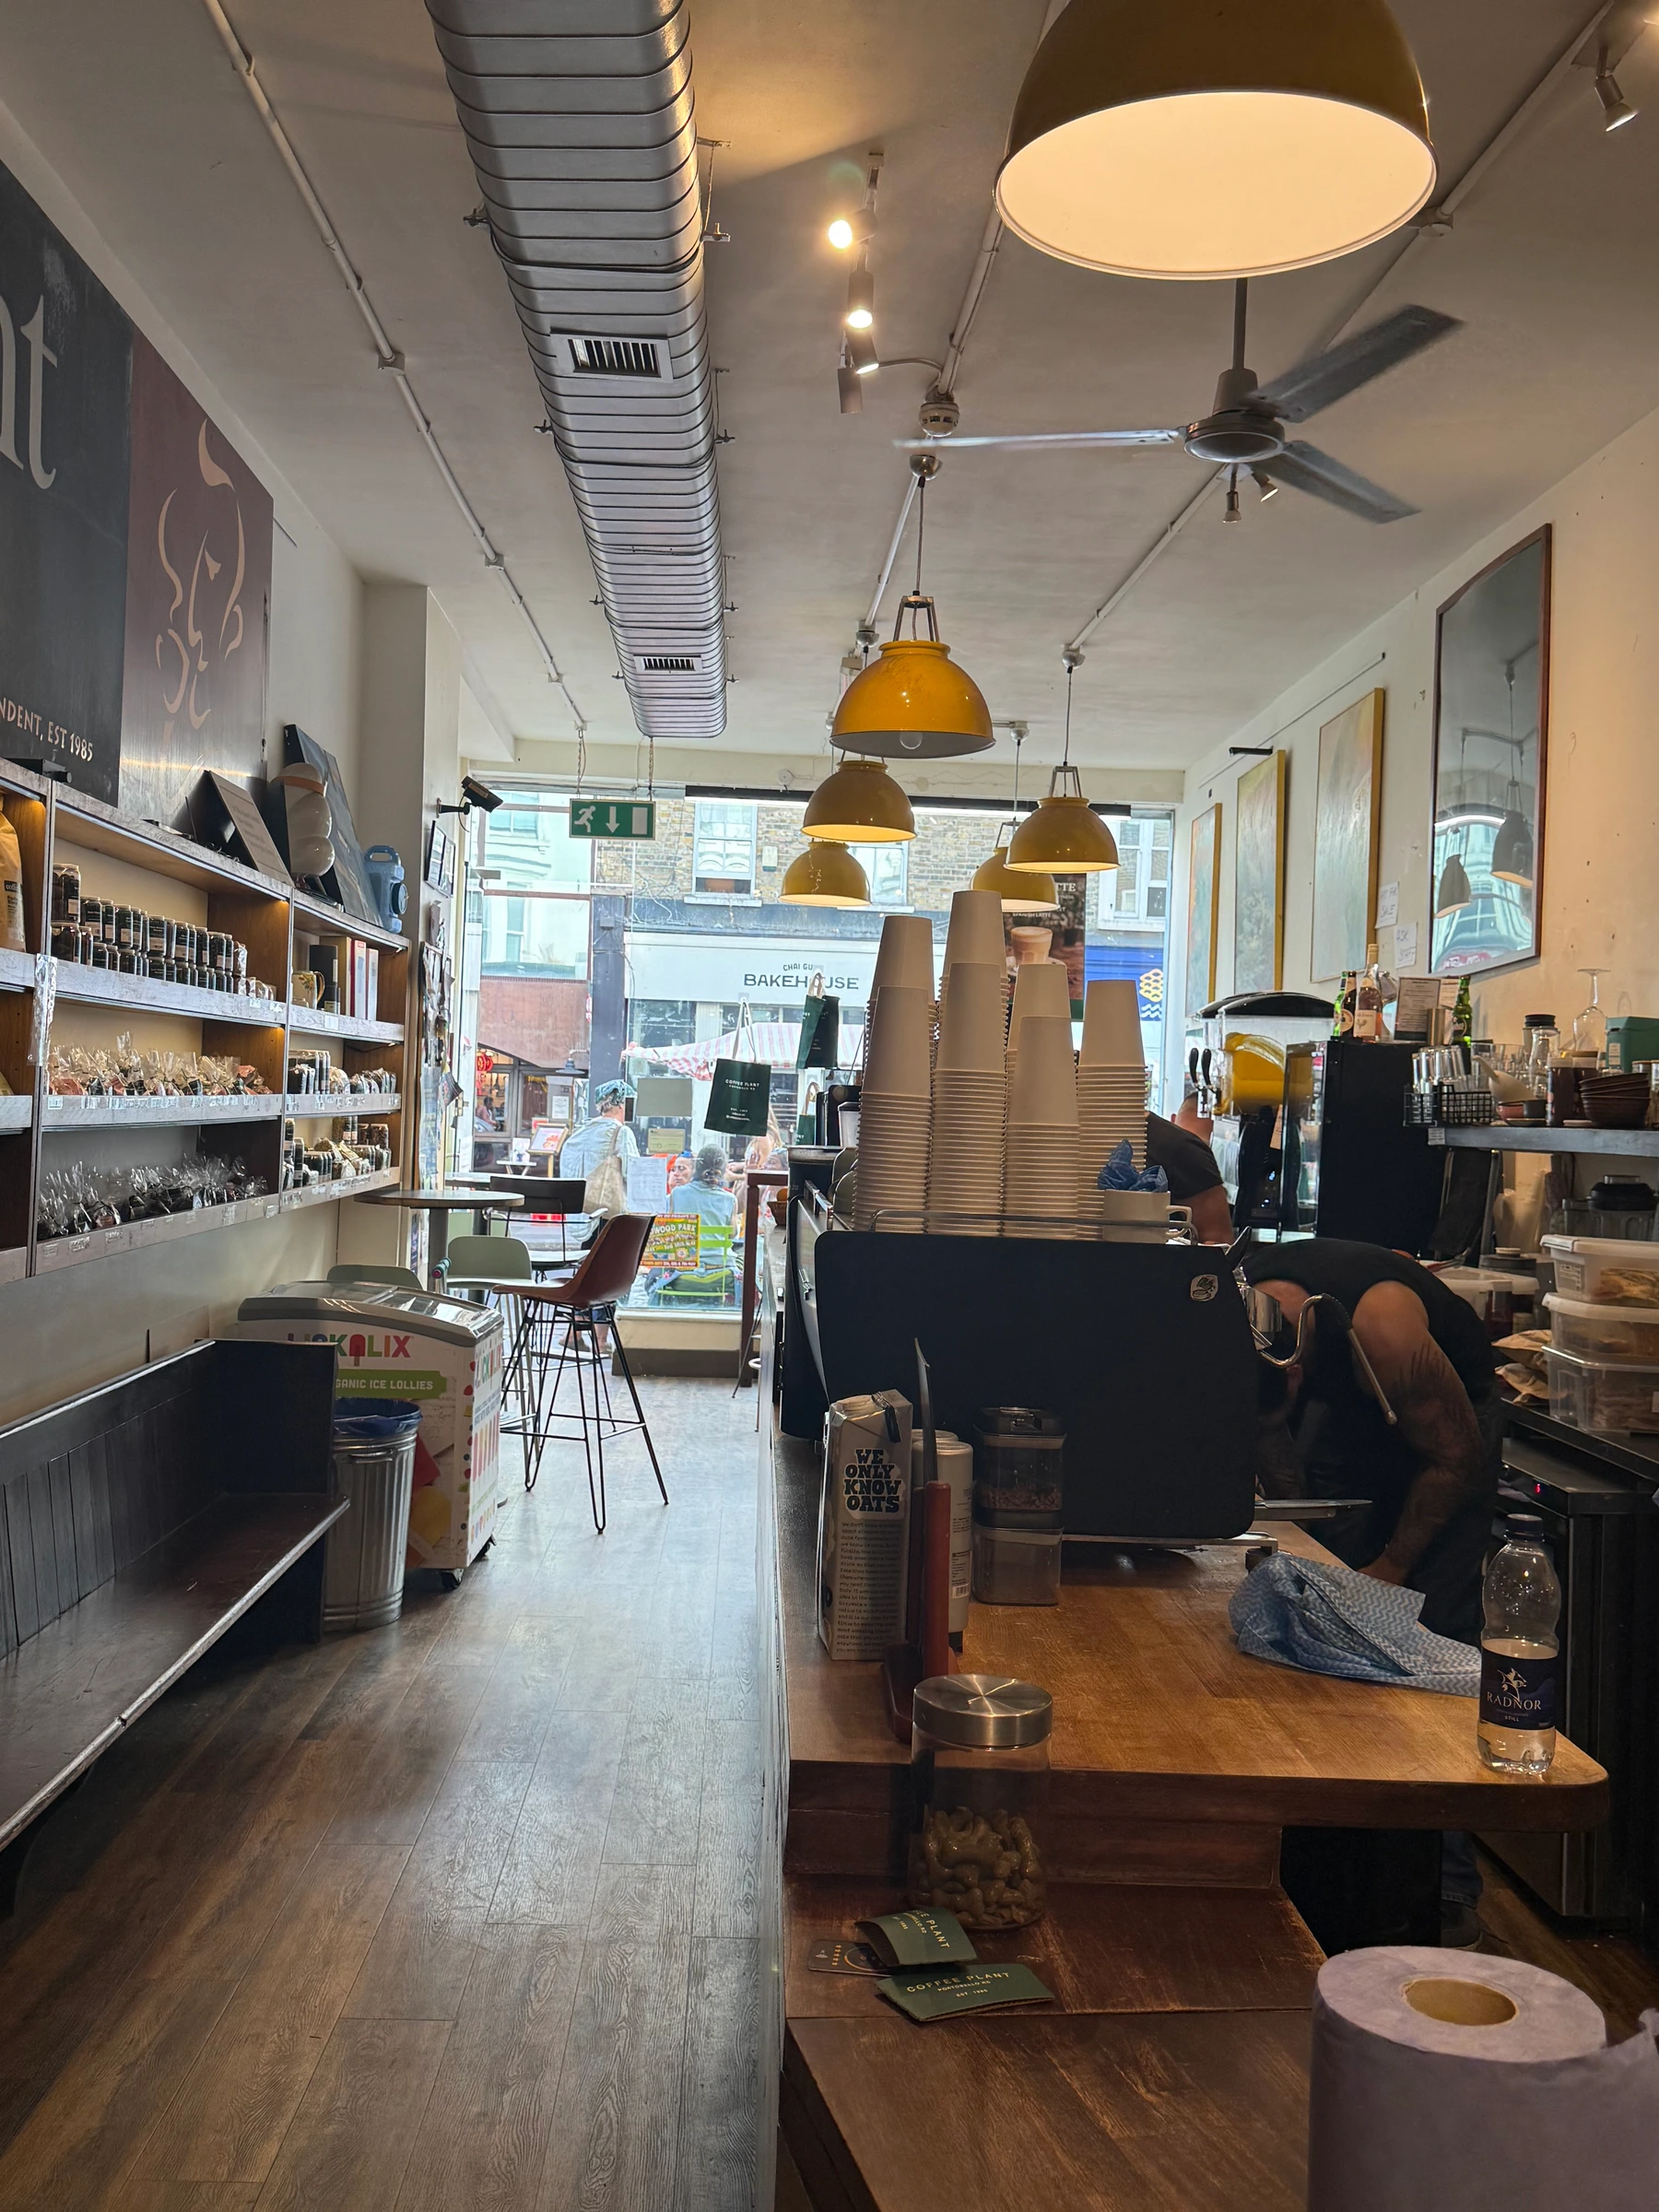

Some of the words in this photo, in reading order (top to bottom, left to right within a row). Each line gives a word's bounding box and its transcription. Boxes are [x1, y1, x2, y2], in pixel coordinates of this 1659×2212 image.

[48, 722, 67, 748] EST
[69, 733, 93, 761] 1985
[782, 963, 801, 971] CHAI
[335, 1378, 366, 1388] GANIC
[370, 1380, 386, 1389] ICE
[390, 1380, 434, 1390] LOLLIES
[855, 1449, 884, 1465] WE
[845, 1464, 895, 1478] ONLY
[844, 1478, 901, 1495] KNOW
[846, 1495, 900, 1512] OATS
[1487, 1691, 1542, 1711] RADNOR
[925, 1920, 950, 1947] PLANT
[907, 1977, 961, 1993] COFFEE
[966, 1972, 1010, 1981] PLANT
[937, 1982, 981, 1992] PORTOBELLO
